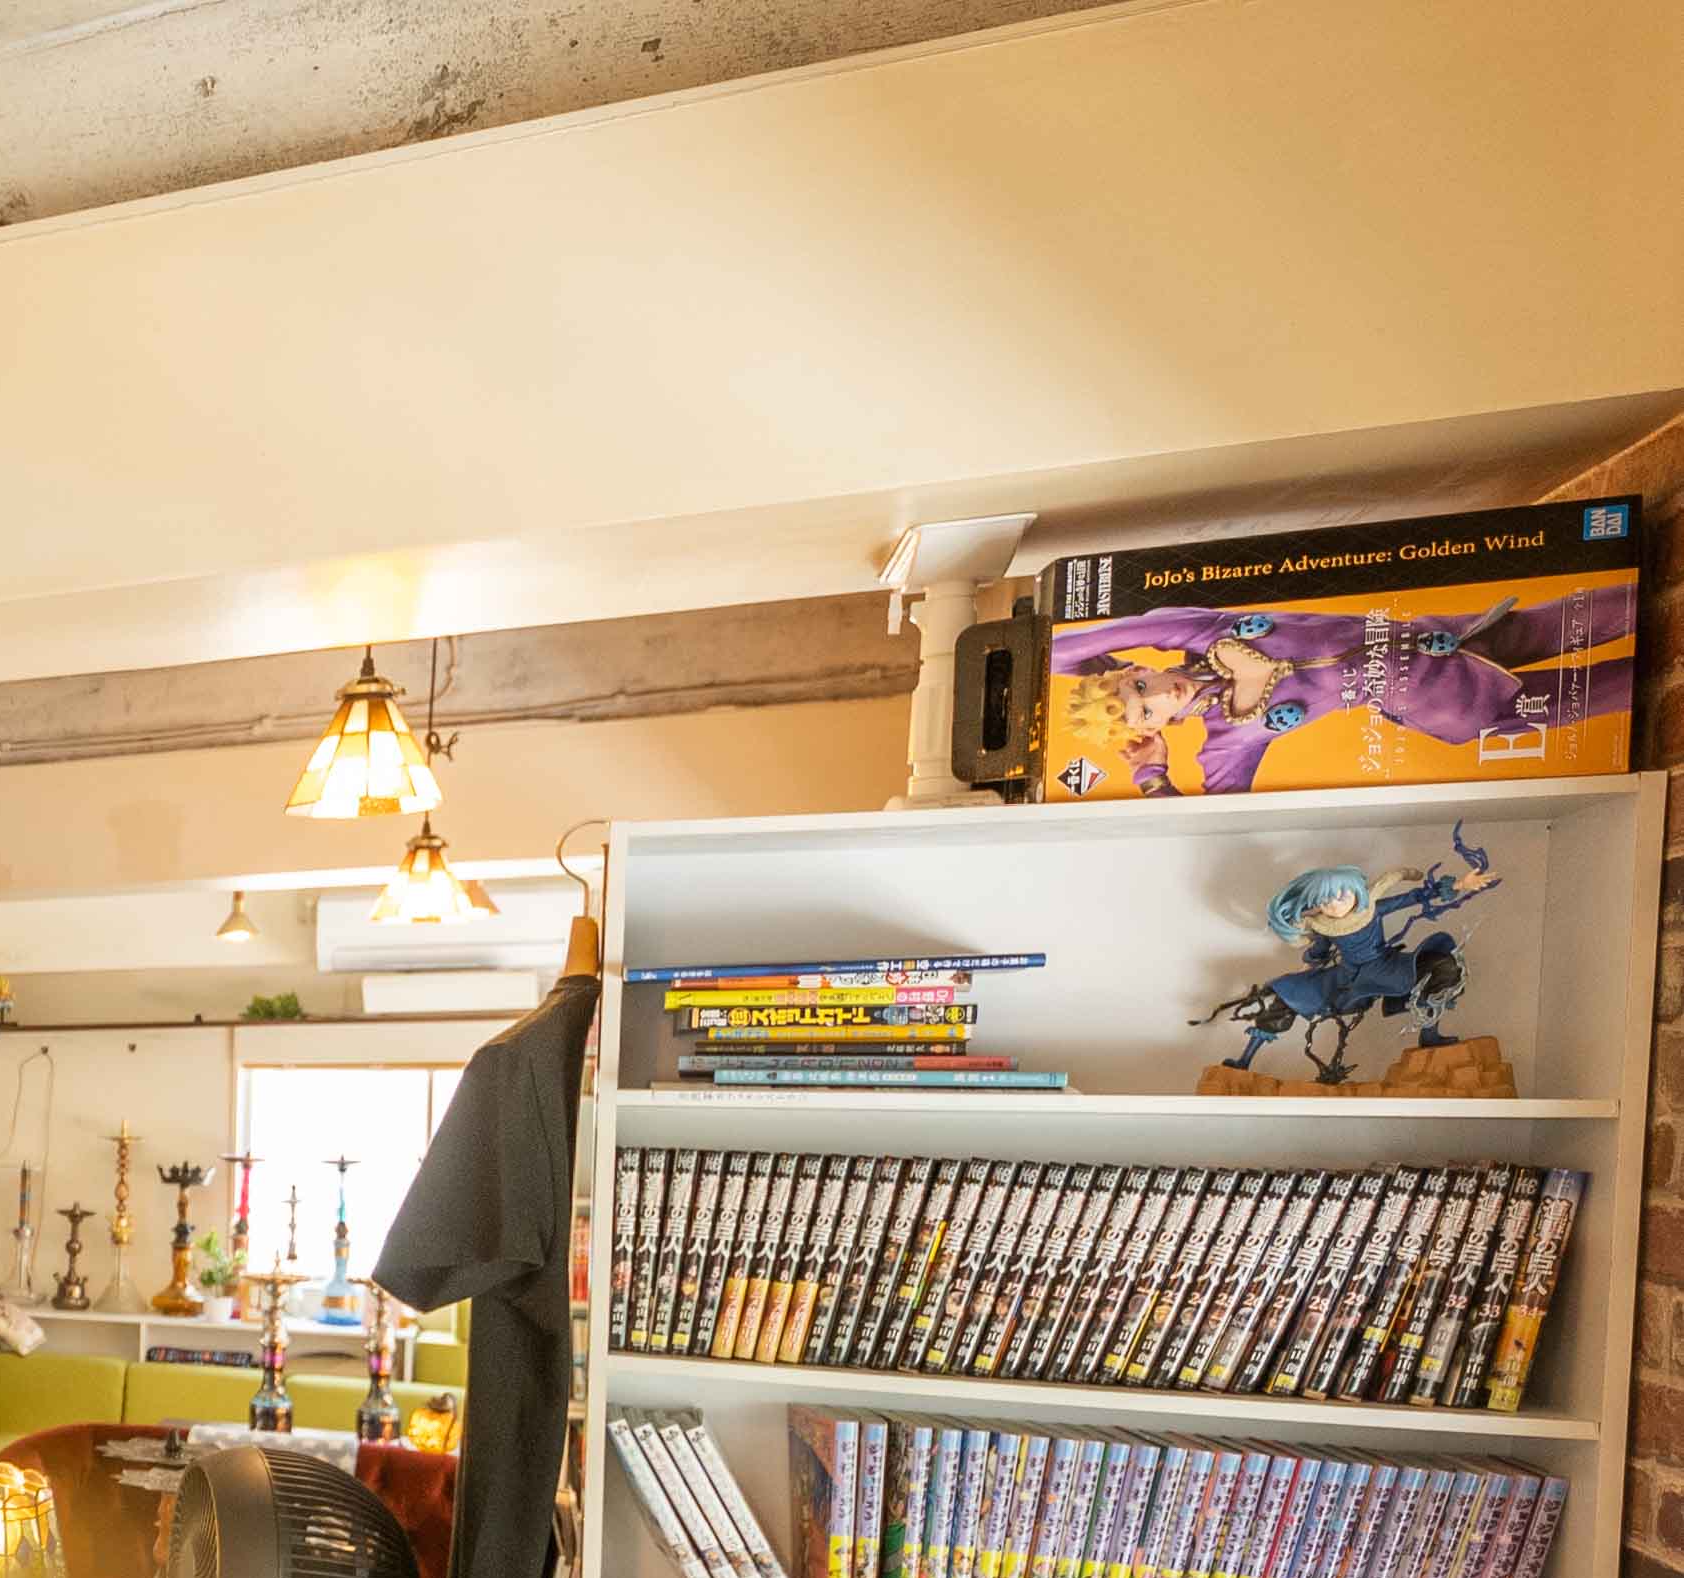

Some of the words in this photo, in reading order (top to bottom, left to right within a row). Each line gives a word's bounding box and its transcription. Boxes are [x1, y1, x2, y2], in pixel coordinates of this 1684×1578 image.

[1590, 508, 1605, 537] BAN
[1606, 511, 1621, 535] DAI
[1144, 567, 1195, 590] JoJo's
[1201, 561, 1273, 582] Bizarre
[1279, 549, 1392, 573] Adventure:
[1399, 541, 1476, 560] Golden
[1484, 530, 1546, 551] Wind
[1399, 610, 1411, 694] ASSEMBLE
[1341, 668, 1357, 714] 一番くじ
[1361, 608, 1390, 774] ジョジョの奇妙な冒険
